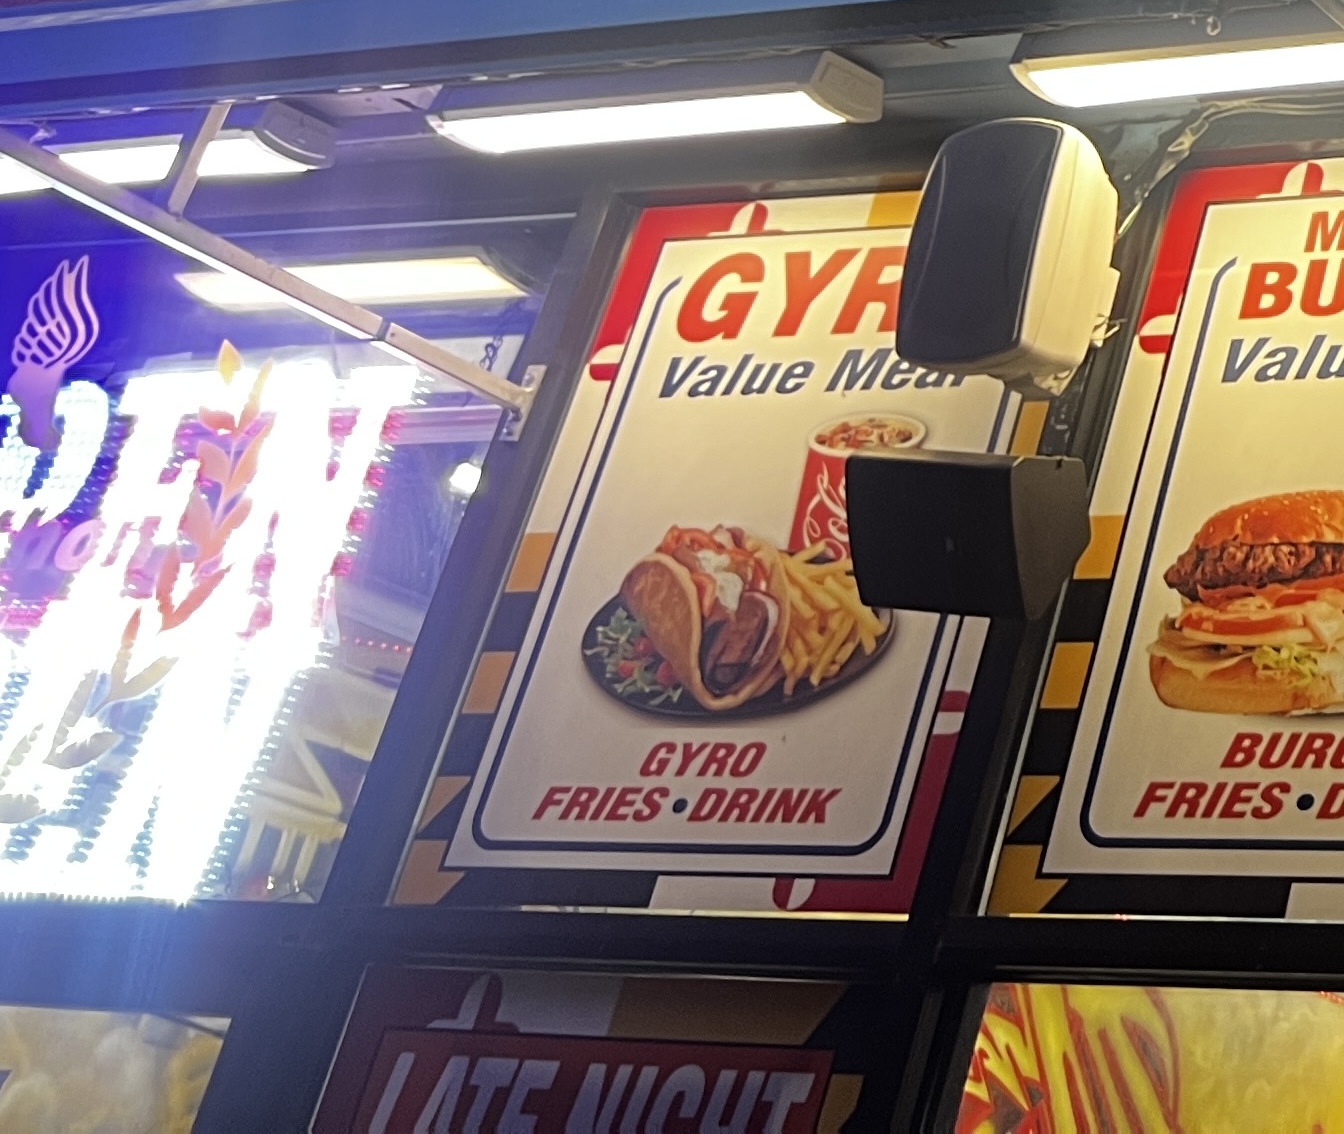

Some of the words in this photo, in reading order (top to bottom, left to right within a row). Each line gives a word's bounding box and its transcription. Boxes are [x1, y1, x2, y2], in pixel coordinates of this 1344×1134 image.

[658, 353, 812, 399] Value
[639, 742, 767, 778] GYRO
[530, 785, 667, 823] FRIES
[686, 787, 842, 825] DRINK
[1133, 781, 1291, 819] FRIES
